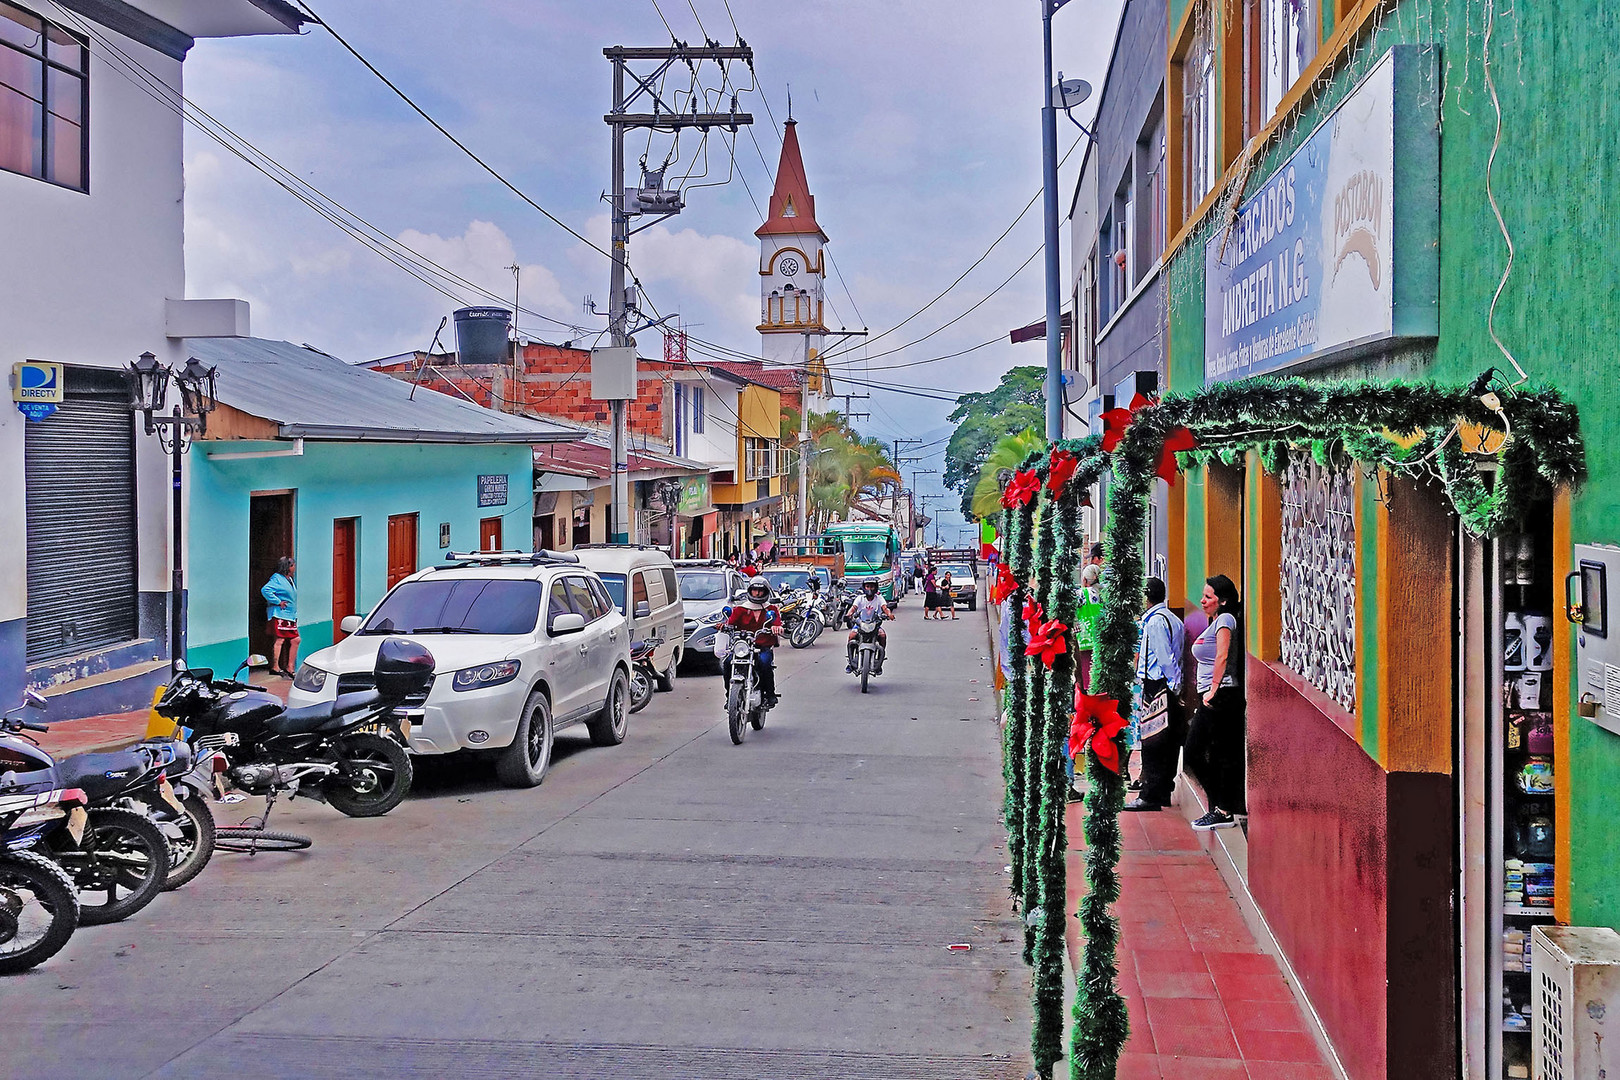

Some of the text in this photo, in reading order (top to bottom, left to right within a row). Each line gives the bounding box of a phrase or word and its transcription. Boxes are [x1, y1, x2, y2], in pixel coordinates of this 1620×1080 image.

[1222, 259, 1274, 338] ANDREITA
[1269, 328, 1275, 358] de
[21, 389, 56, 398] DIRECTV
